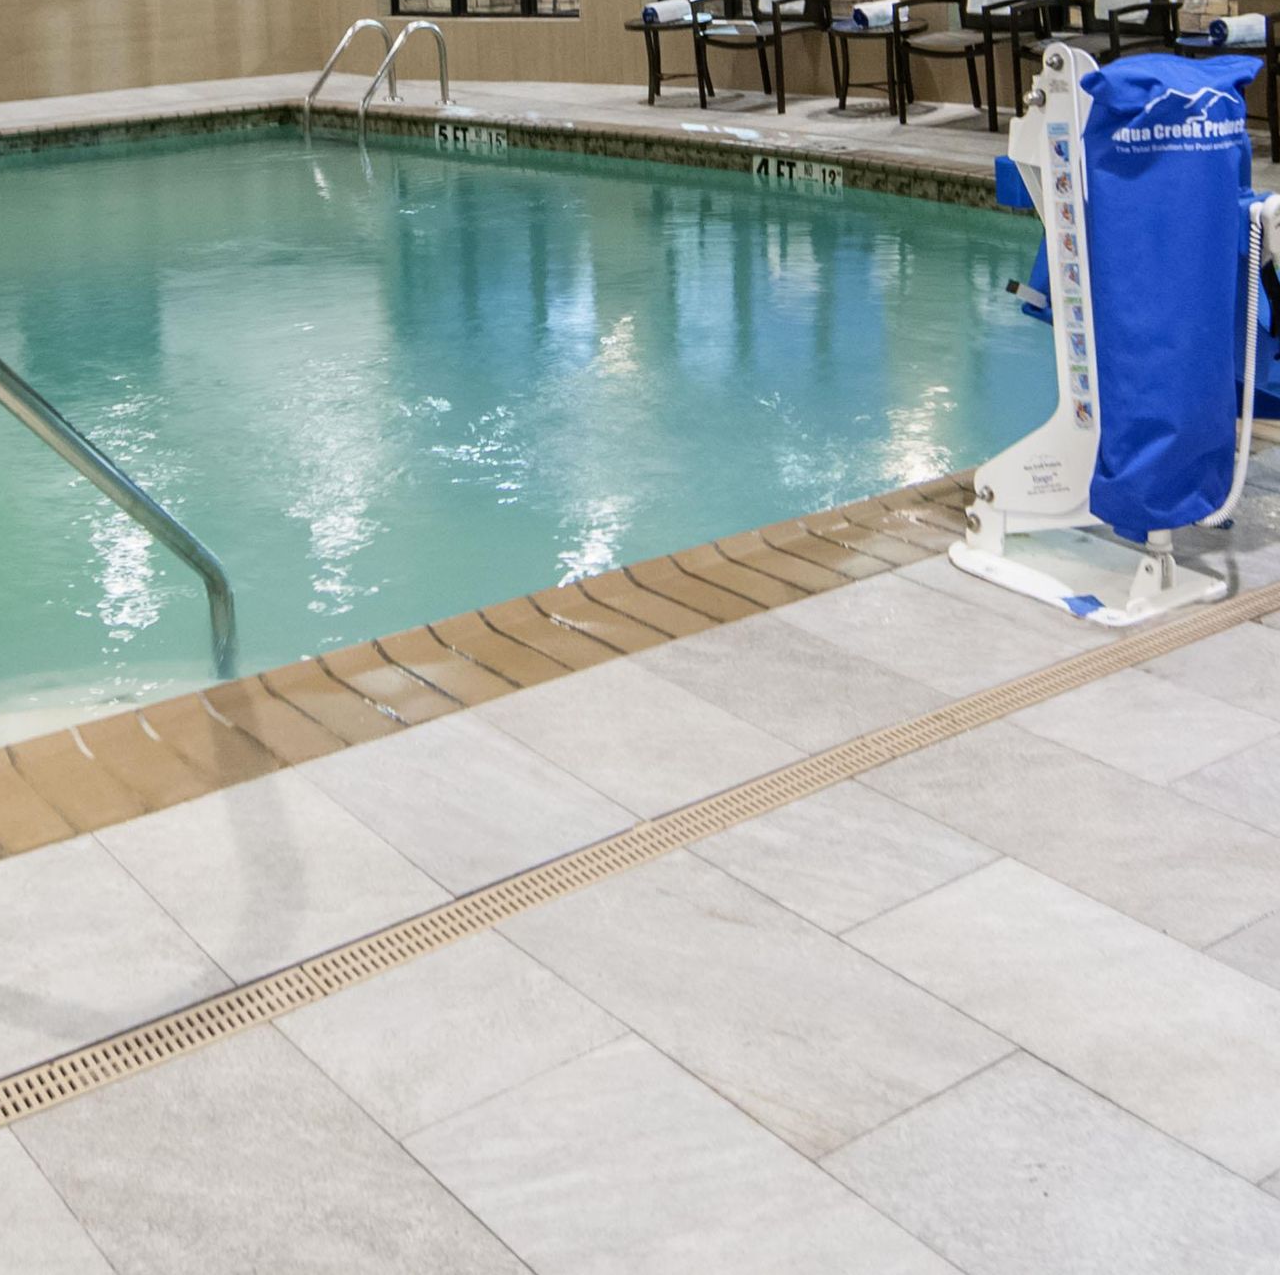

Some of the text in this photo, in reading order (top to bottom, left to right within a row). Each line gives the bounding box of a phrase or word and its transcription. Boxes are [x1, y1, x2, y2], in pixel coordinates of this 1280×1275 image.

[453, 126, 469, 142] FT
[1153, 122, 1202, 140] Creek
[777, 159, 797, 179] FT
